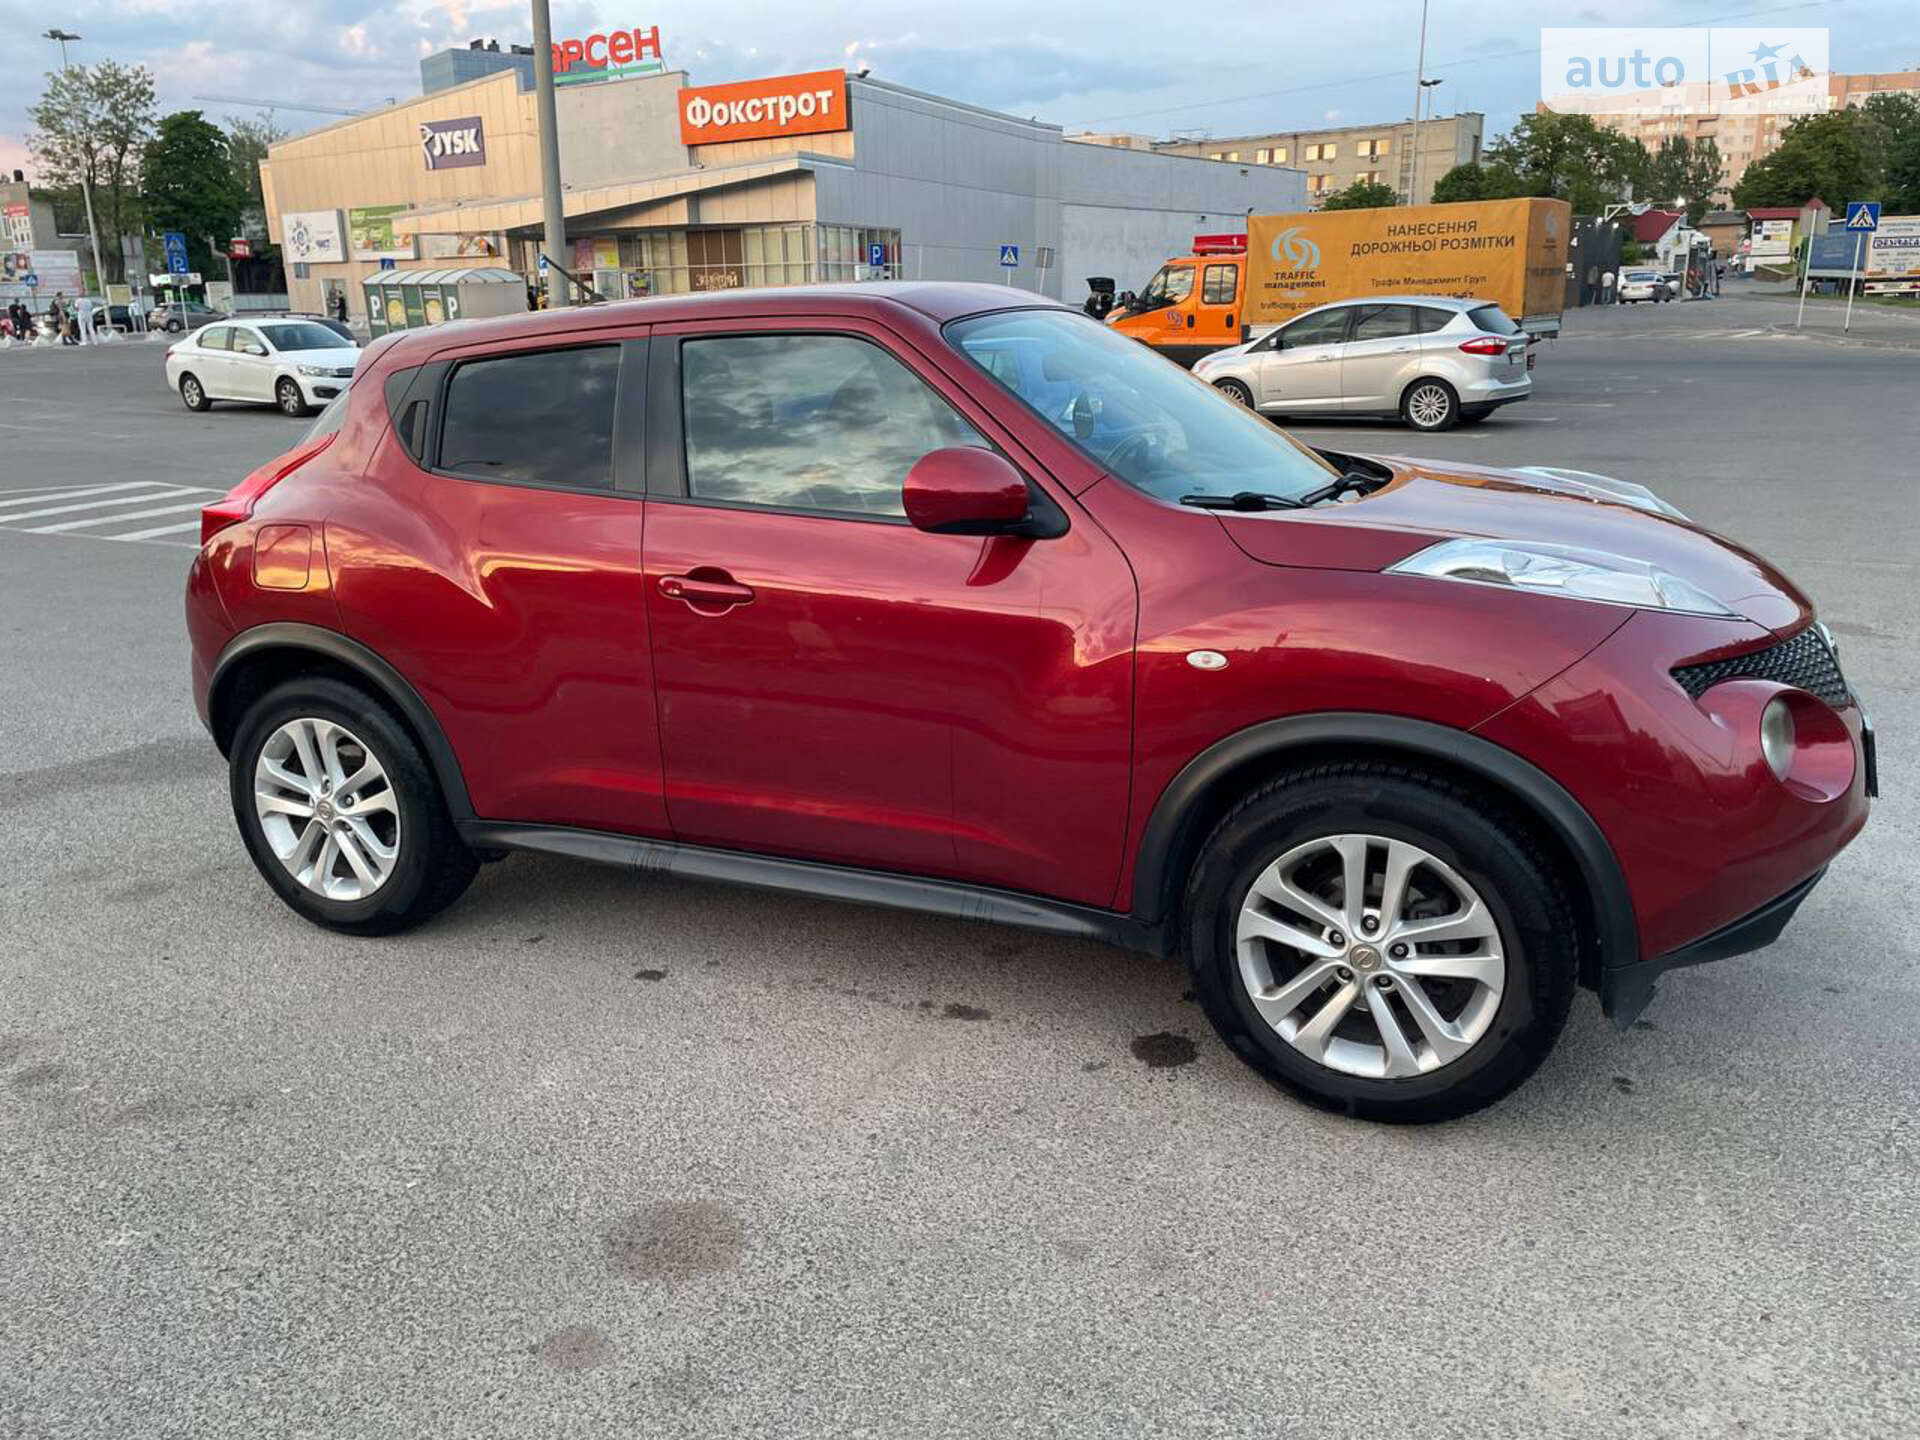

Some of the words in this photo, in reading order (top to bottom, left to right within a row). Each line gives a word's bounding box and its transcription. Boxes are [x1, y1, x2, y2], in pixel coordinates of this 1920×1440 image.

[686, 89, 833, 129] Фокстрот
[433, 128, 480, 157] JYSK
[1387, 220, 1477, 237] НАНЕСЕННЯ
[1440, 235, 1516, 251] РОЗМІТКИ
[872, 245, 881, 264] P
[1264, 280, 1326, 290] management
[1274, 271, 1315, 281] TRAFFIC
[370, 295, 380, 318] P
[447, 296, 458, 320] P
